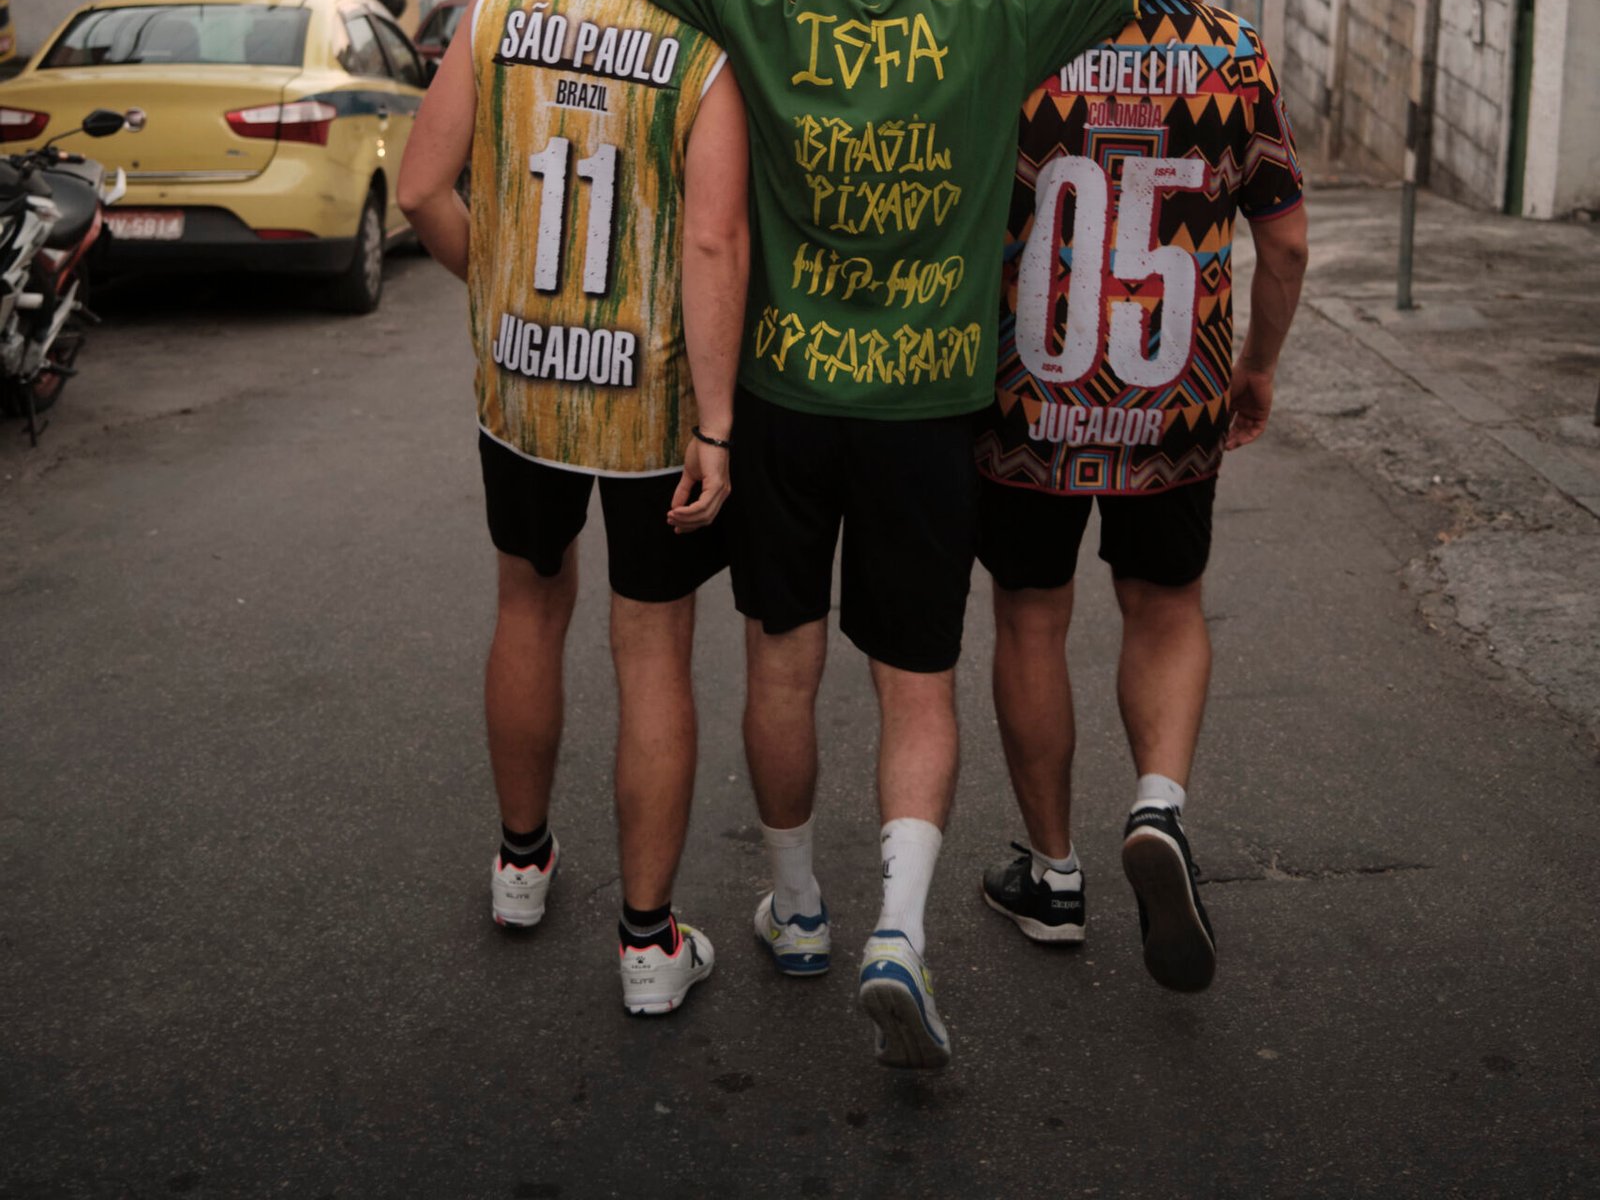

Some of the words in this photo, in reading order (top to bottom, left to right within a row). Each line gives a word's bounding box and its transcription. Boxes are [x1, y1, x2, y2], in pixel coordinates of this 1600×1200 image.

[501, 2, 568, 64] SÃO
[573, 22, 680, 85] PAULO
[792, 11, 949, 90] ISFA
[1060, 38, 1199, 95] MEDELLÍN
[555, 79, 609, 112] BRAZIL
[1087, 101, 1163, 127] COLOMBIA
[1154, 167, 1177, 177] ISFA
[528, 136, 621, 296] 11
[1014, 155, 1208, 389] 05
[493, 313, 636, 387] JUGADOR
[1028, 402, 1164, 446] JUGADOR
